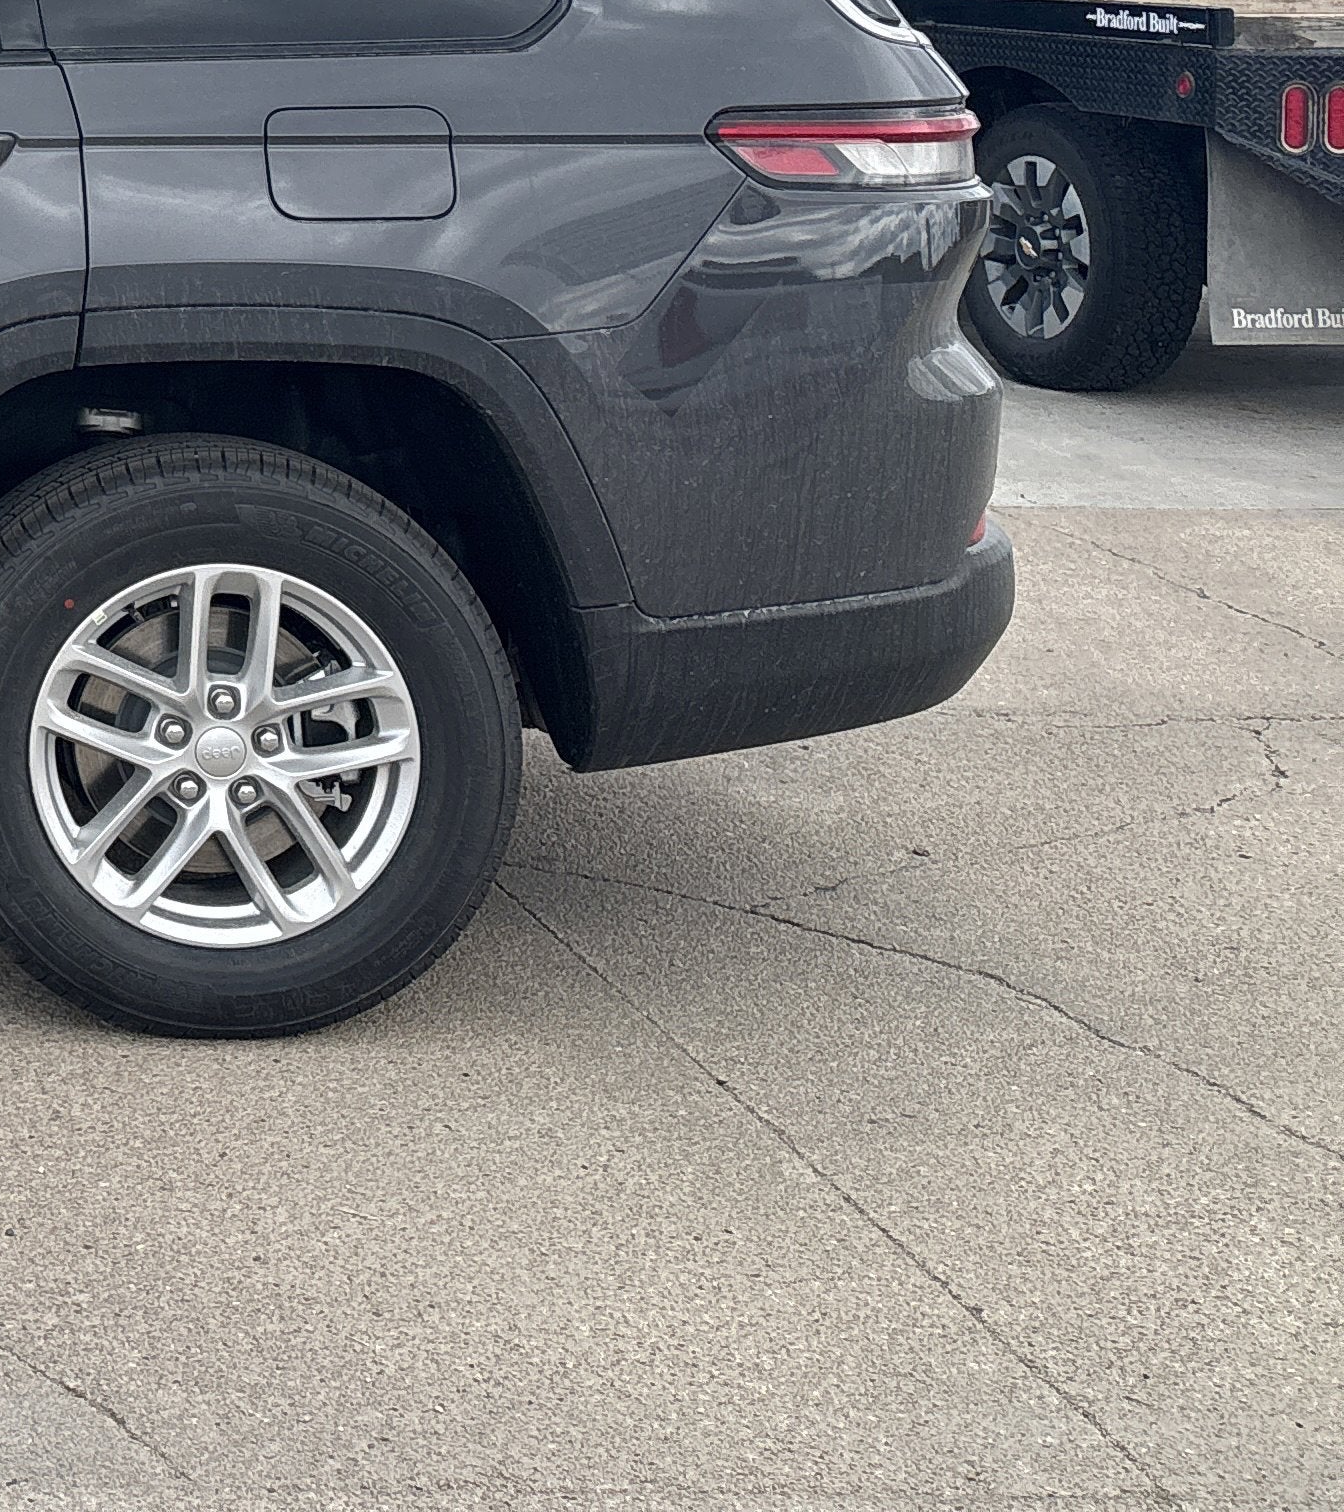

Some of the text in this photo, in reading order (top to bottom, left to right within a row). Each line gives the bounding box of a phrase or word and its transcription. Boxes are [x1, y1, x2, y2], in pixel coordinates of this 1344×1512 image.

[1095, 7, 1179, 35] Bradford Built
[1231, 307, 1315, 329] Bradford
[304, 525, 438, 623] MICHELIN
